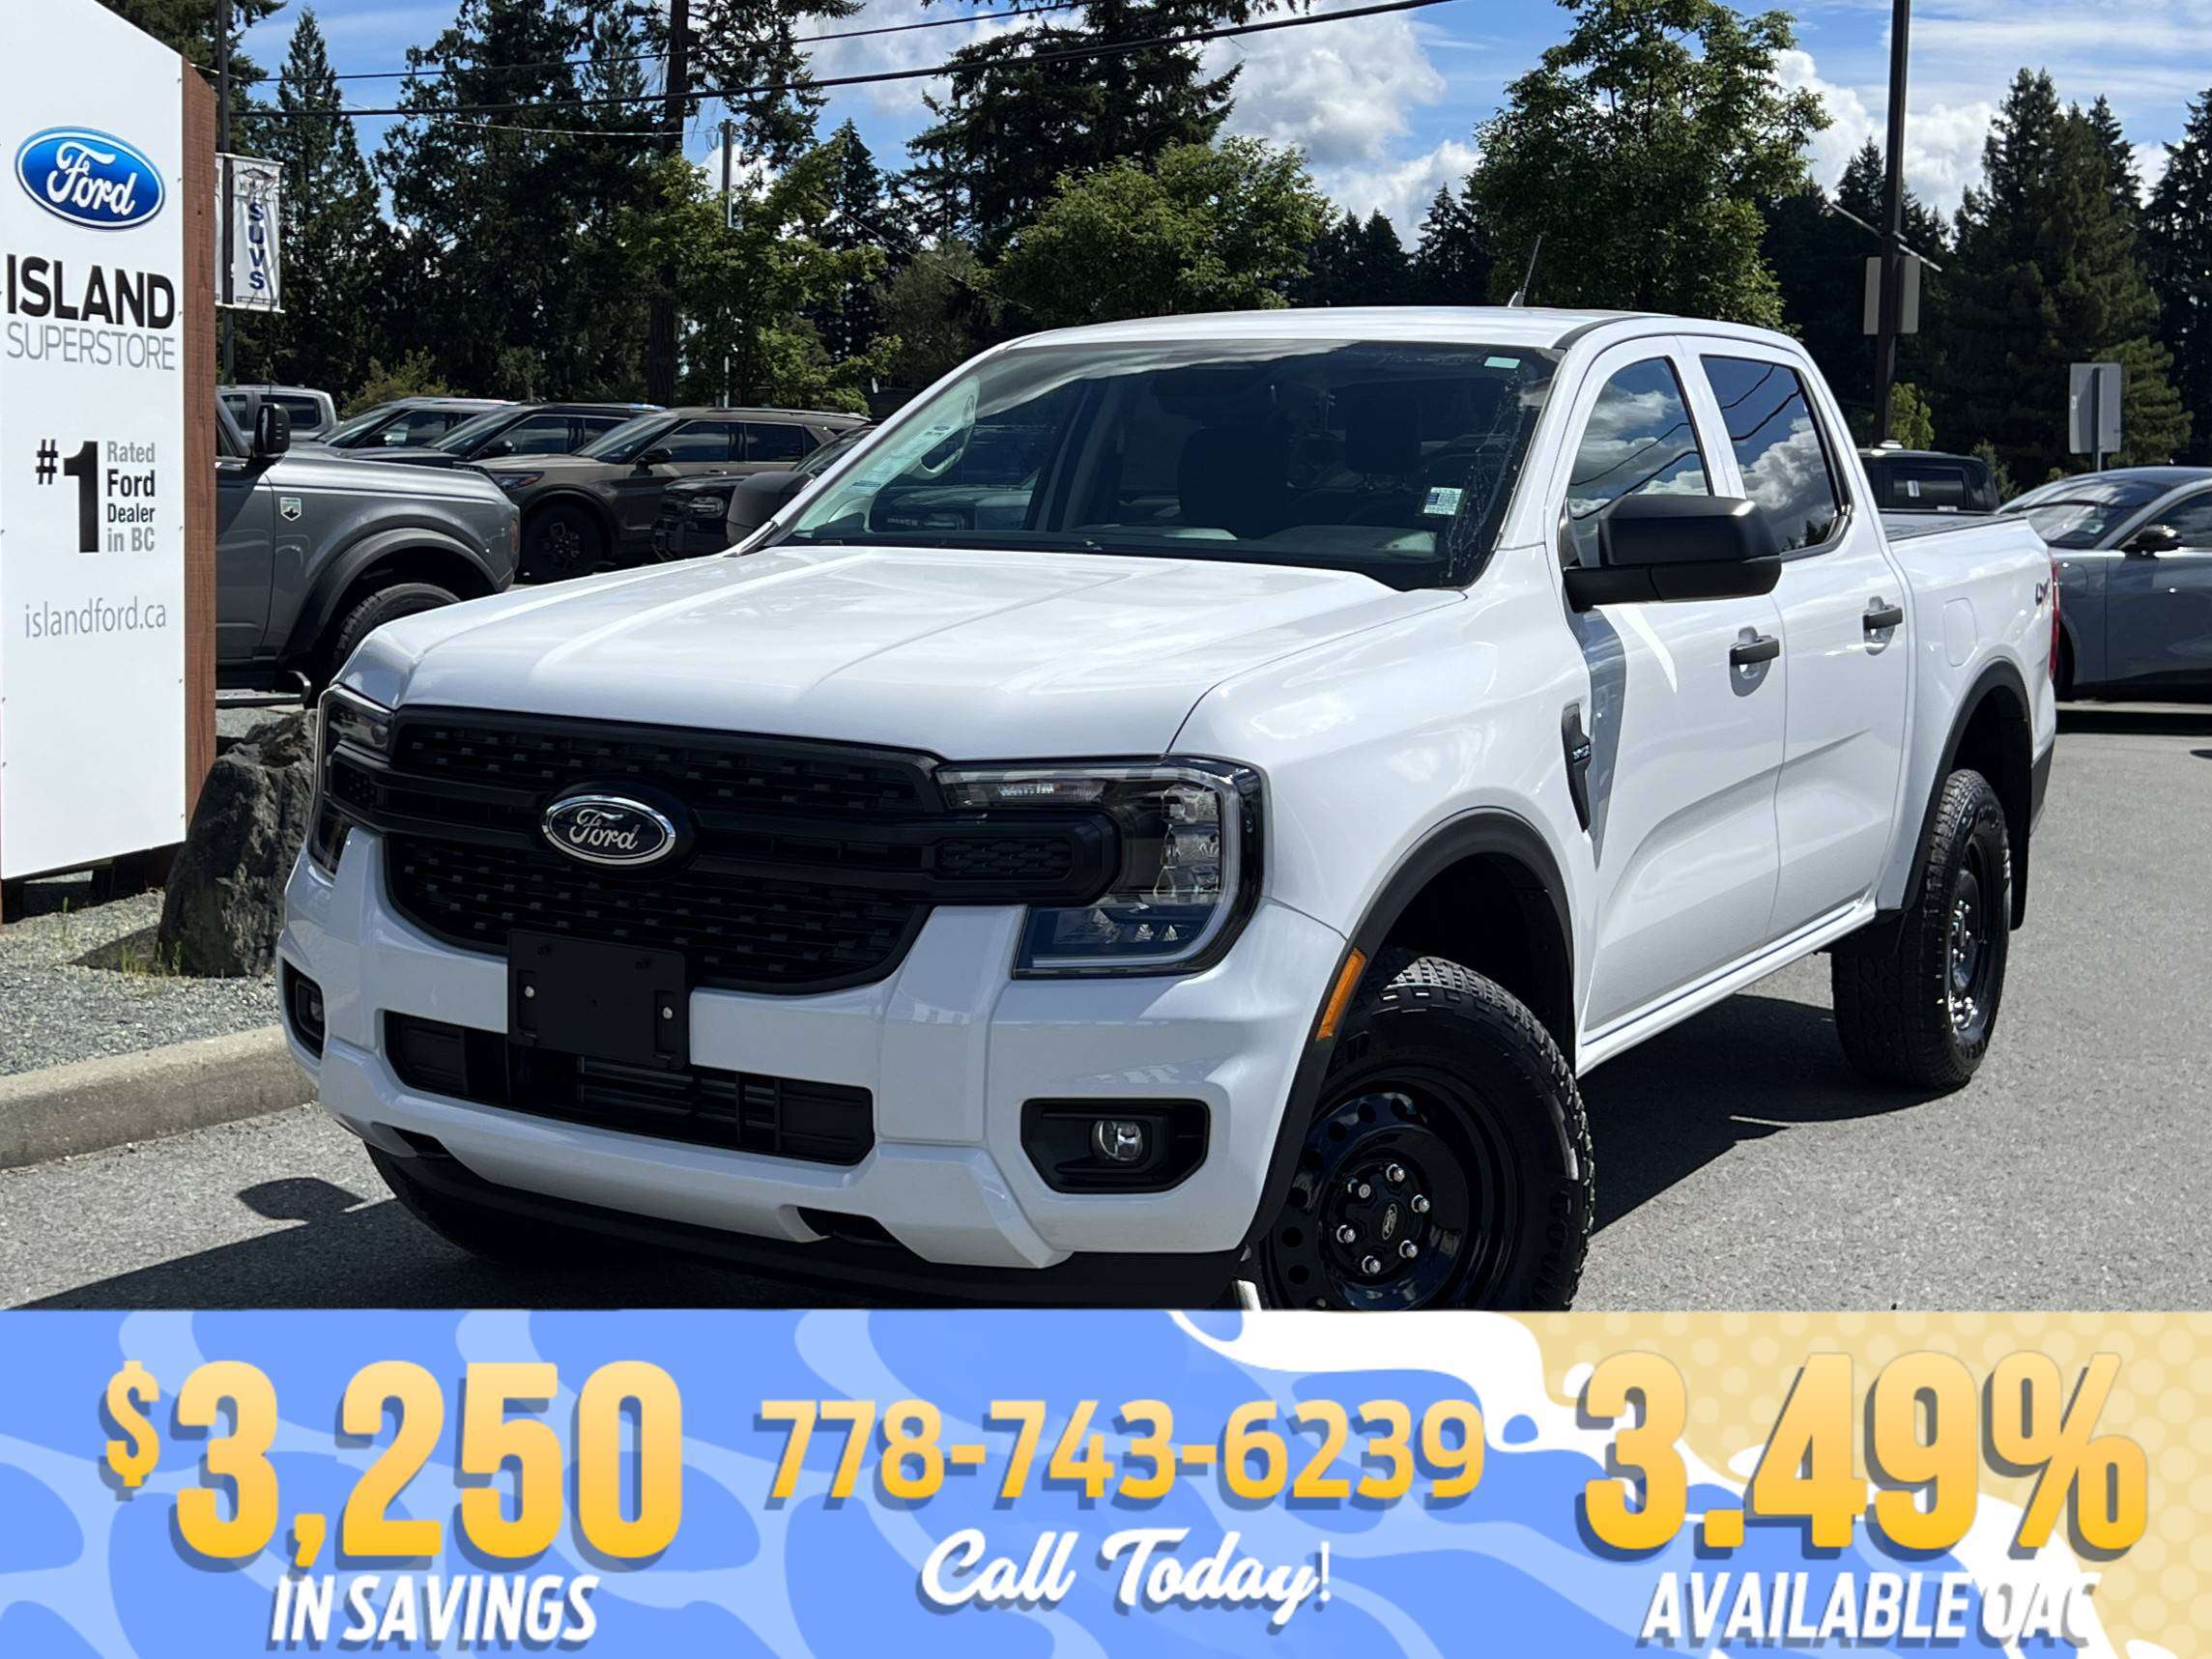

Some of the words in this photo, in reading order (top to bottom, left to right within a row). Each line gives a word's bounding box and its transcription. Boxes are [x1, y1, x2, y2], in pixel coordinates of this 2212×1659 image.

[46, 141, 137, 215] Ford
[247, 203, 266, 290] SUVS
[7, 253, 175, 329] ISLAND
[7, 321, 175, 370] SUPERSTORE
[106, 441, 156, 463] Rated
[36, 439, 100, 554] #1
[106, 469, 156, 497] Ford
[106, 502, 156, 523] Dealer
[107, 528, 125, 552] in
[131, 527, 156, 552] BC
[25, 596, 166, 639] islandford.ca
[569, 809, 641, 849] Ford
